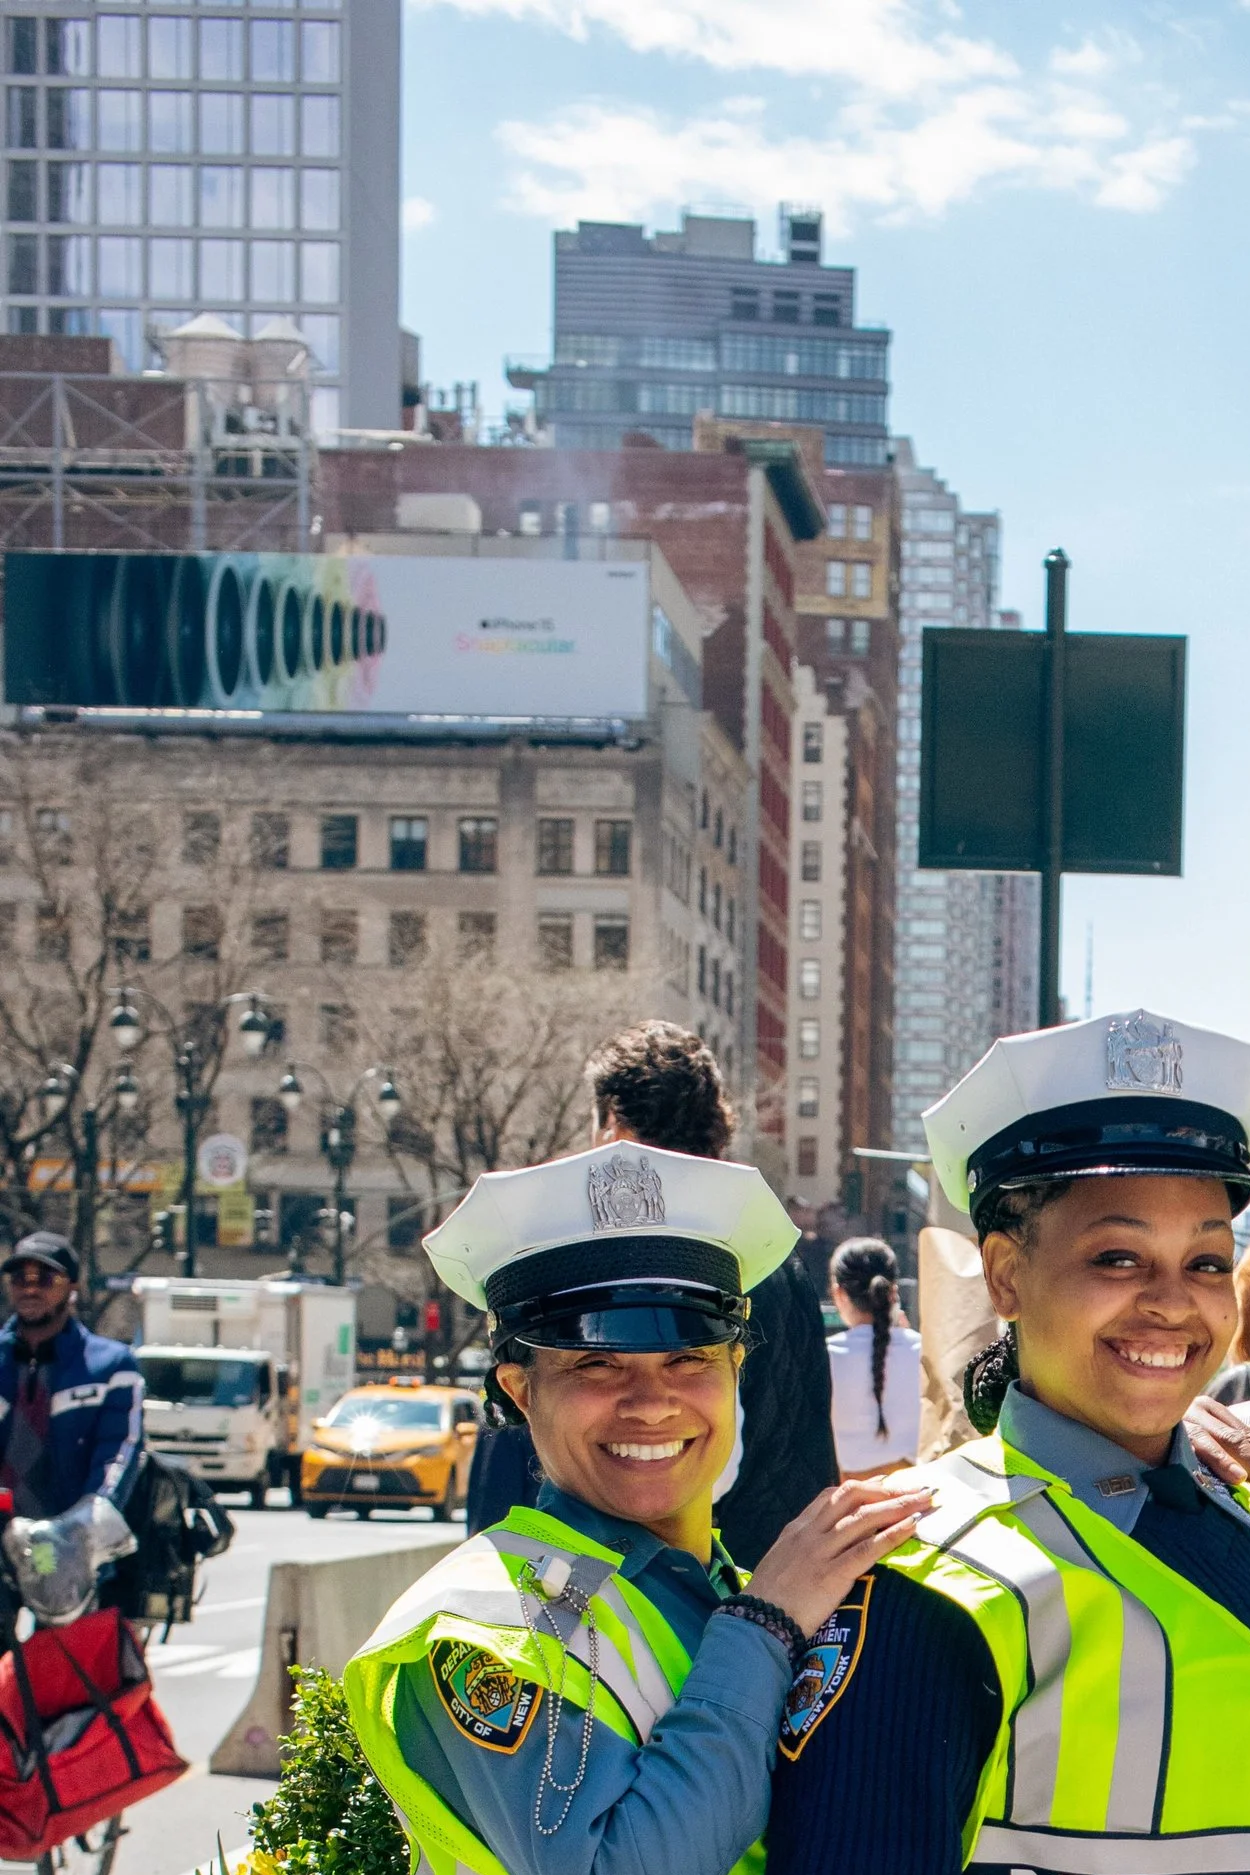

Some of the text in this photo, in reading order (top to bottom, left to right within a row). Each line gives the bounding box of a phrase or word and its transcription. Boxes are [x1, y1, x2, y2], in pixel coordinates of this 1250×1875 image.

[450, 1692, 533, 1737] CITY OF NEW
[802, 1700, 825, 1733] NEW
[824, 1655, 850, 1695] YORK
